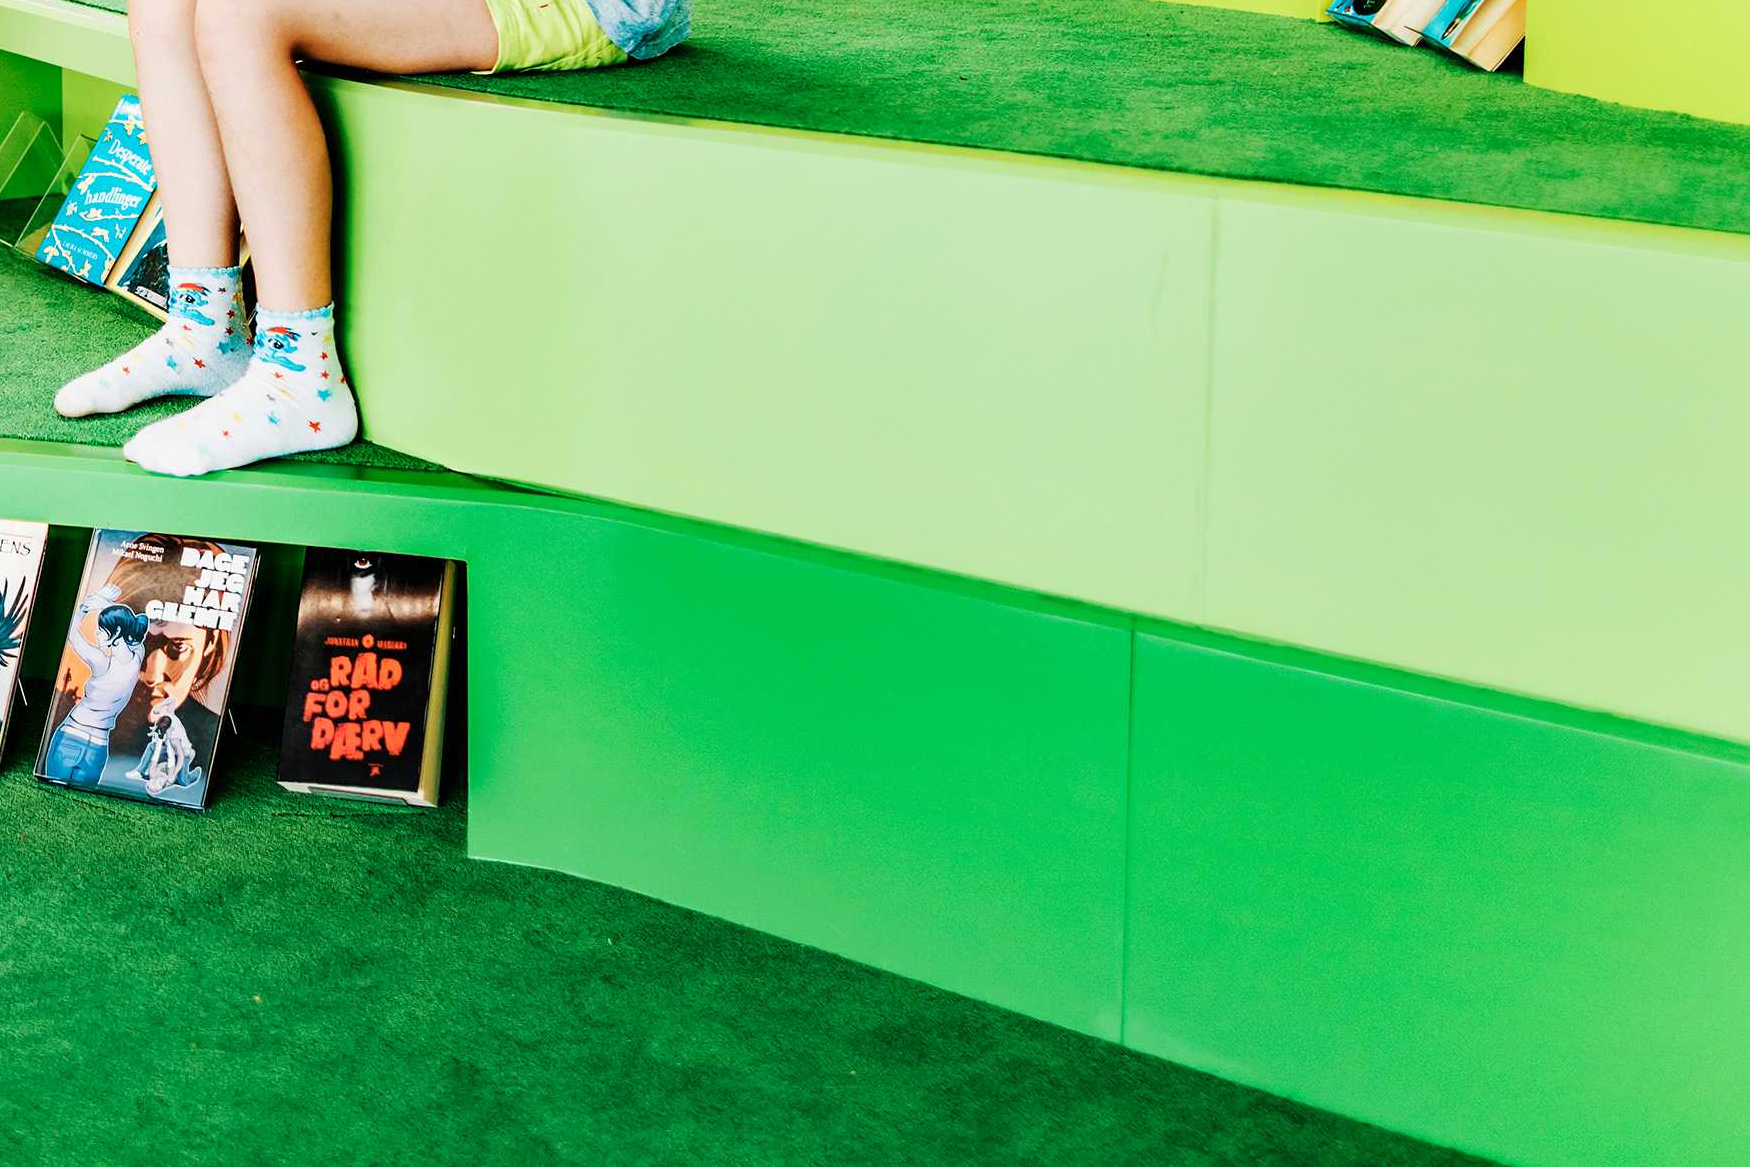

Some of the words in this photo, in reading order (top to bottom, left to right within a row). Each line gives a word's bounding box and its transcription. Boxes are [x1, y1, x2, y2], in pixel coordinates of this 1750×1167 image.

[108, 138, 153, 176] Desperate
[84, 186, 143, 211] handlinger
[120, 540, 139, 551] Arne
[139, 542, 165, 554] Svingen
[135, 551, 163, 563] Noguchi
[195, 569, 245, 593] JEG
[183, 586, 241, 612] HAR
[146, 599, 238, 631] GLEMT
[311, 678, 329, 691] OG
[303, 689, 370, 722] FOR
[311, 716, 410, 760] DÆRV
